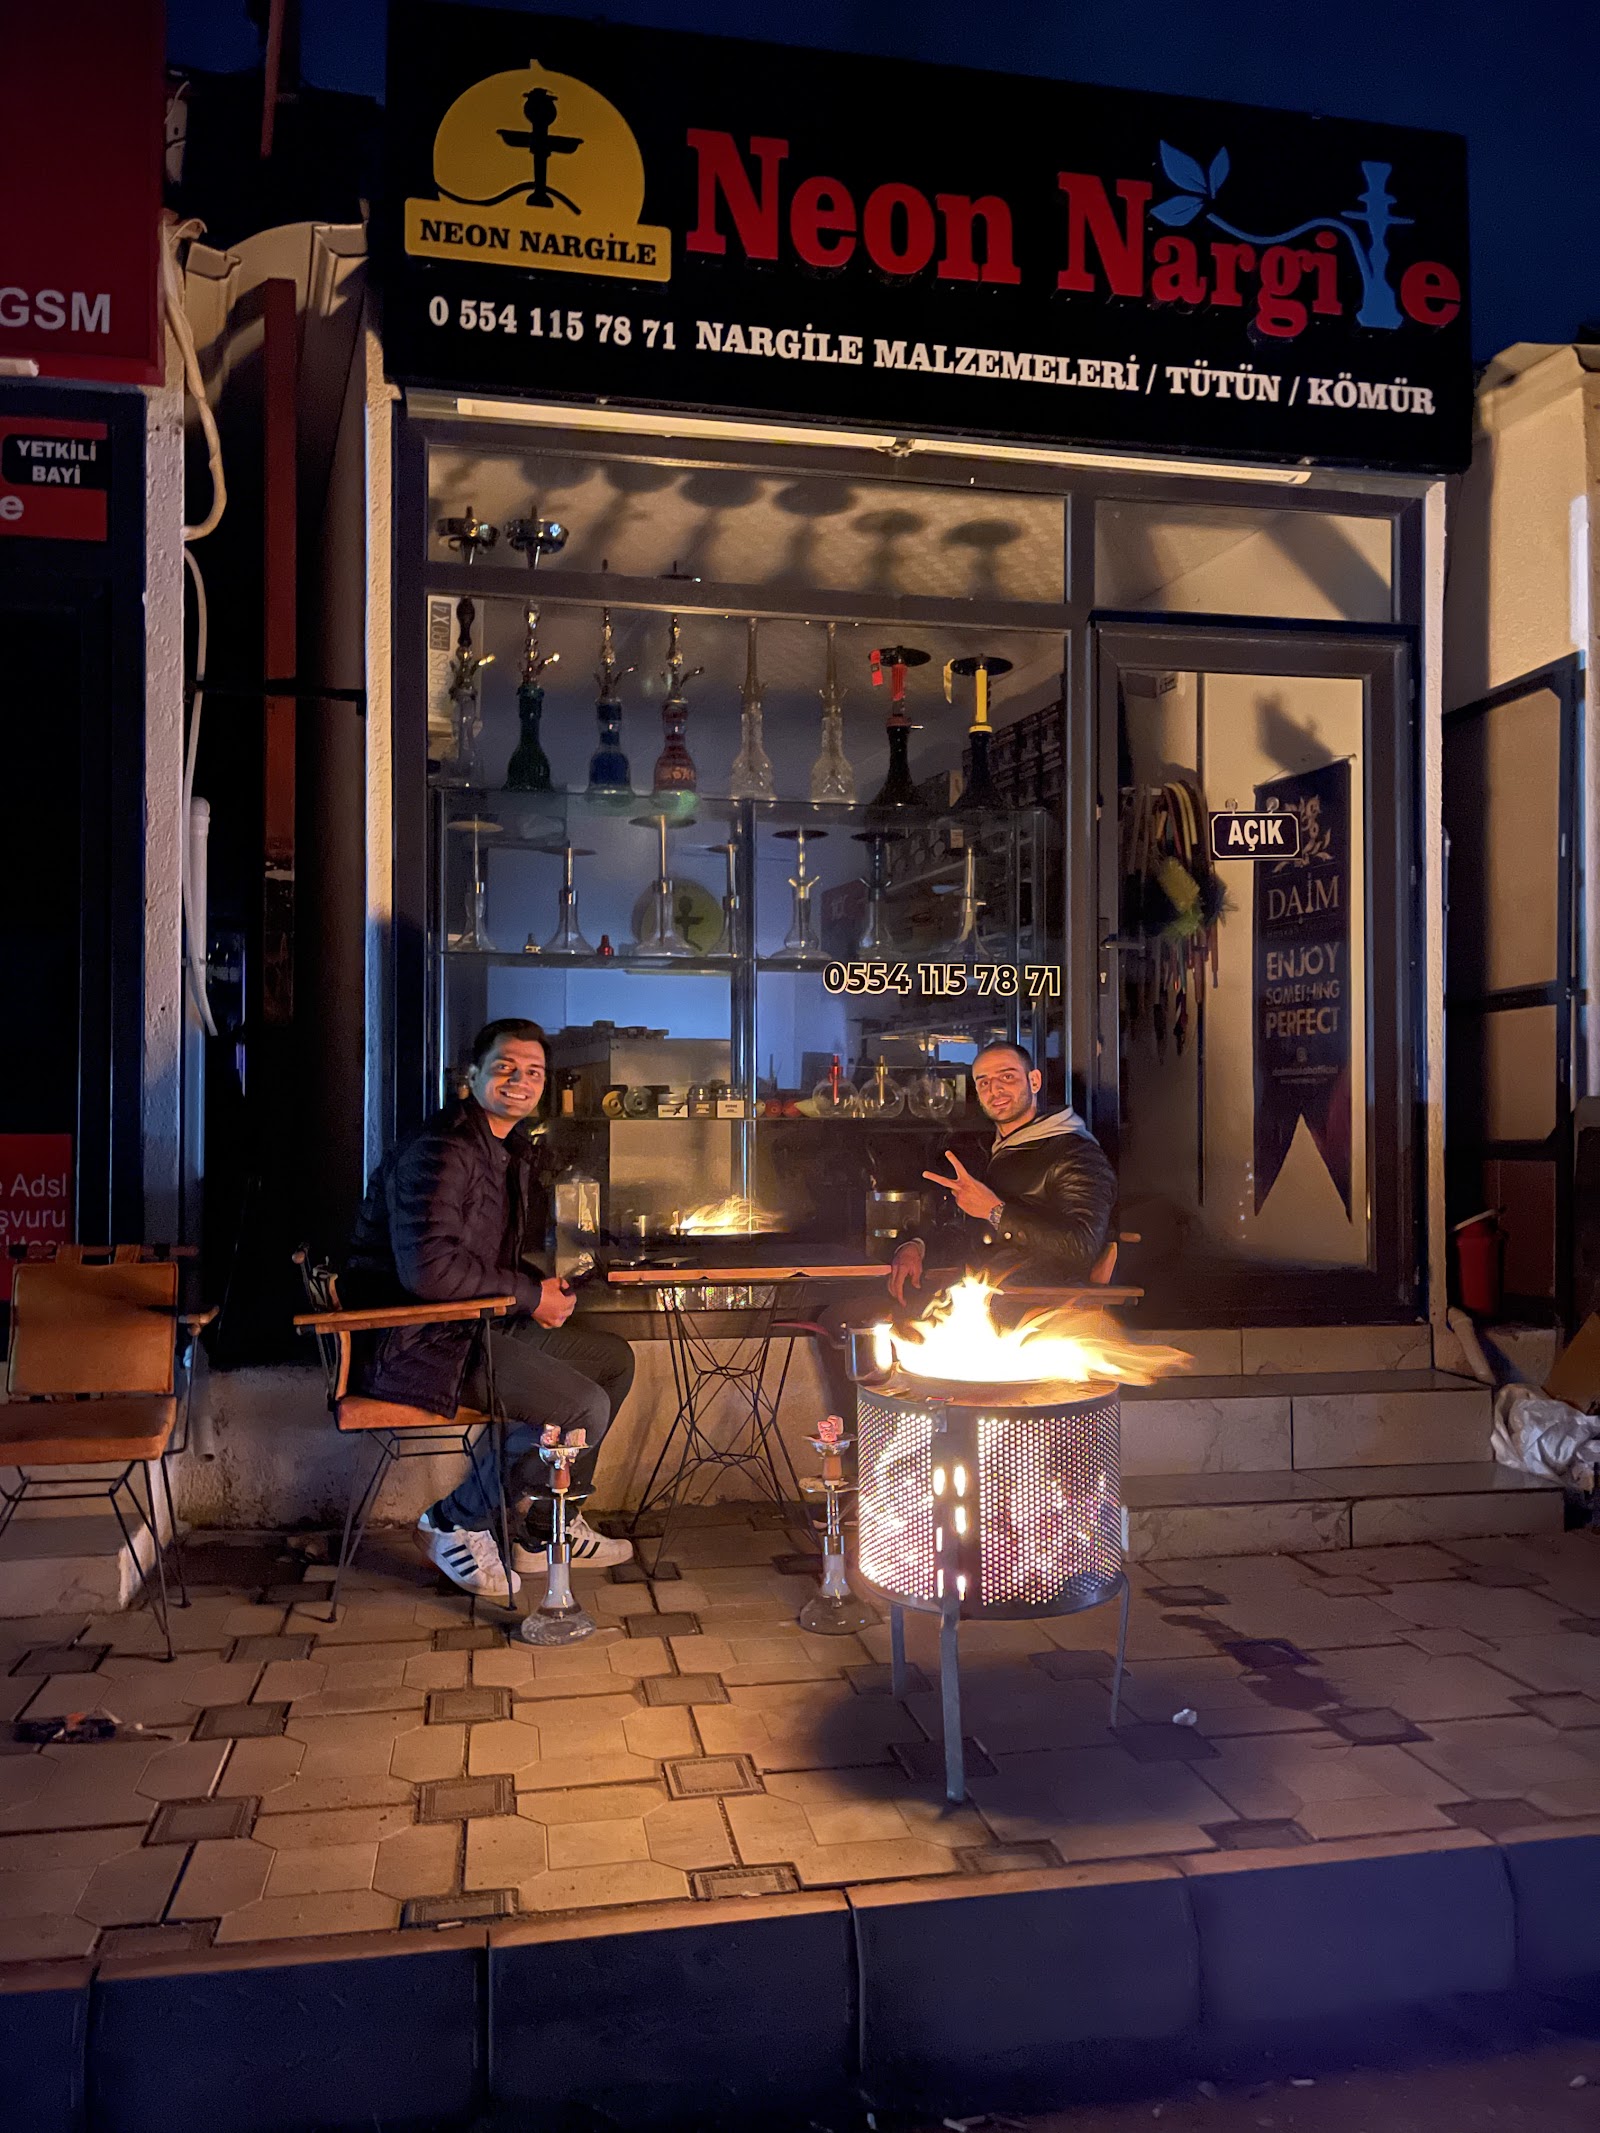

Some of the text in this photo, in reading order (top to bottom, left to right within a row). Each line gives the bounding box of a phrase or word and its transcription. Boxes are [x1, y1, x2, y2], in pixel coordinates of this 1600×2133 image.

[686, 127, 1021, 285] Neon
[420, 218, 657, 267] NEON NARGİLE
[0, 287, 111, 334] GSM
[428, 296, 449, 327] 0
[459, 300, 517, 334] 554
[530, 307, 583, 341] 115
[595, 314, 632, 346] 78
[642, 319, 676, 351] 71
[695, 321, 864, 365] NARGİLE
[873, 339, 1140, 392] MALZEMELERİ
[1165, 359, 1282, 402] TÜTÜN
[1307, 371, 1436, 415] KÖMÜR
[16, 439, 97, 462] YETKİLİ
[32, 464, 81, 485] BAYİ
[1227, 819, 1284, 852] AÇIK
[823, 961, 1061, 996] 0554 115 78 71
[1266, 942, 1341, 982] ENJOY
[1265, 1006, 1341, 1039] PERFECT
[10, 1173, 67, 1198] Adsl
